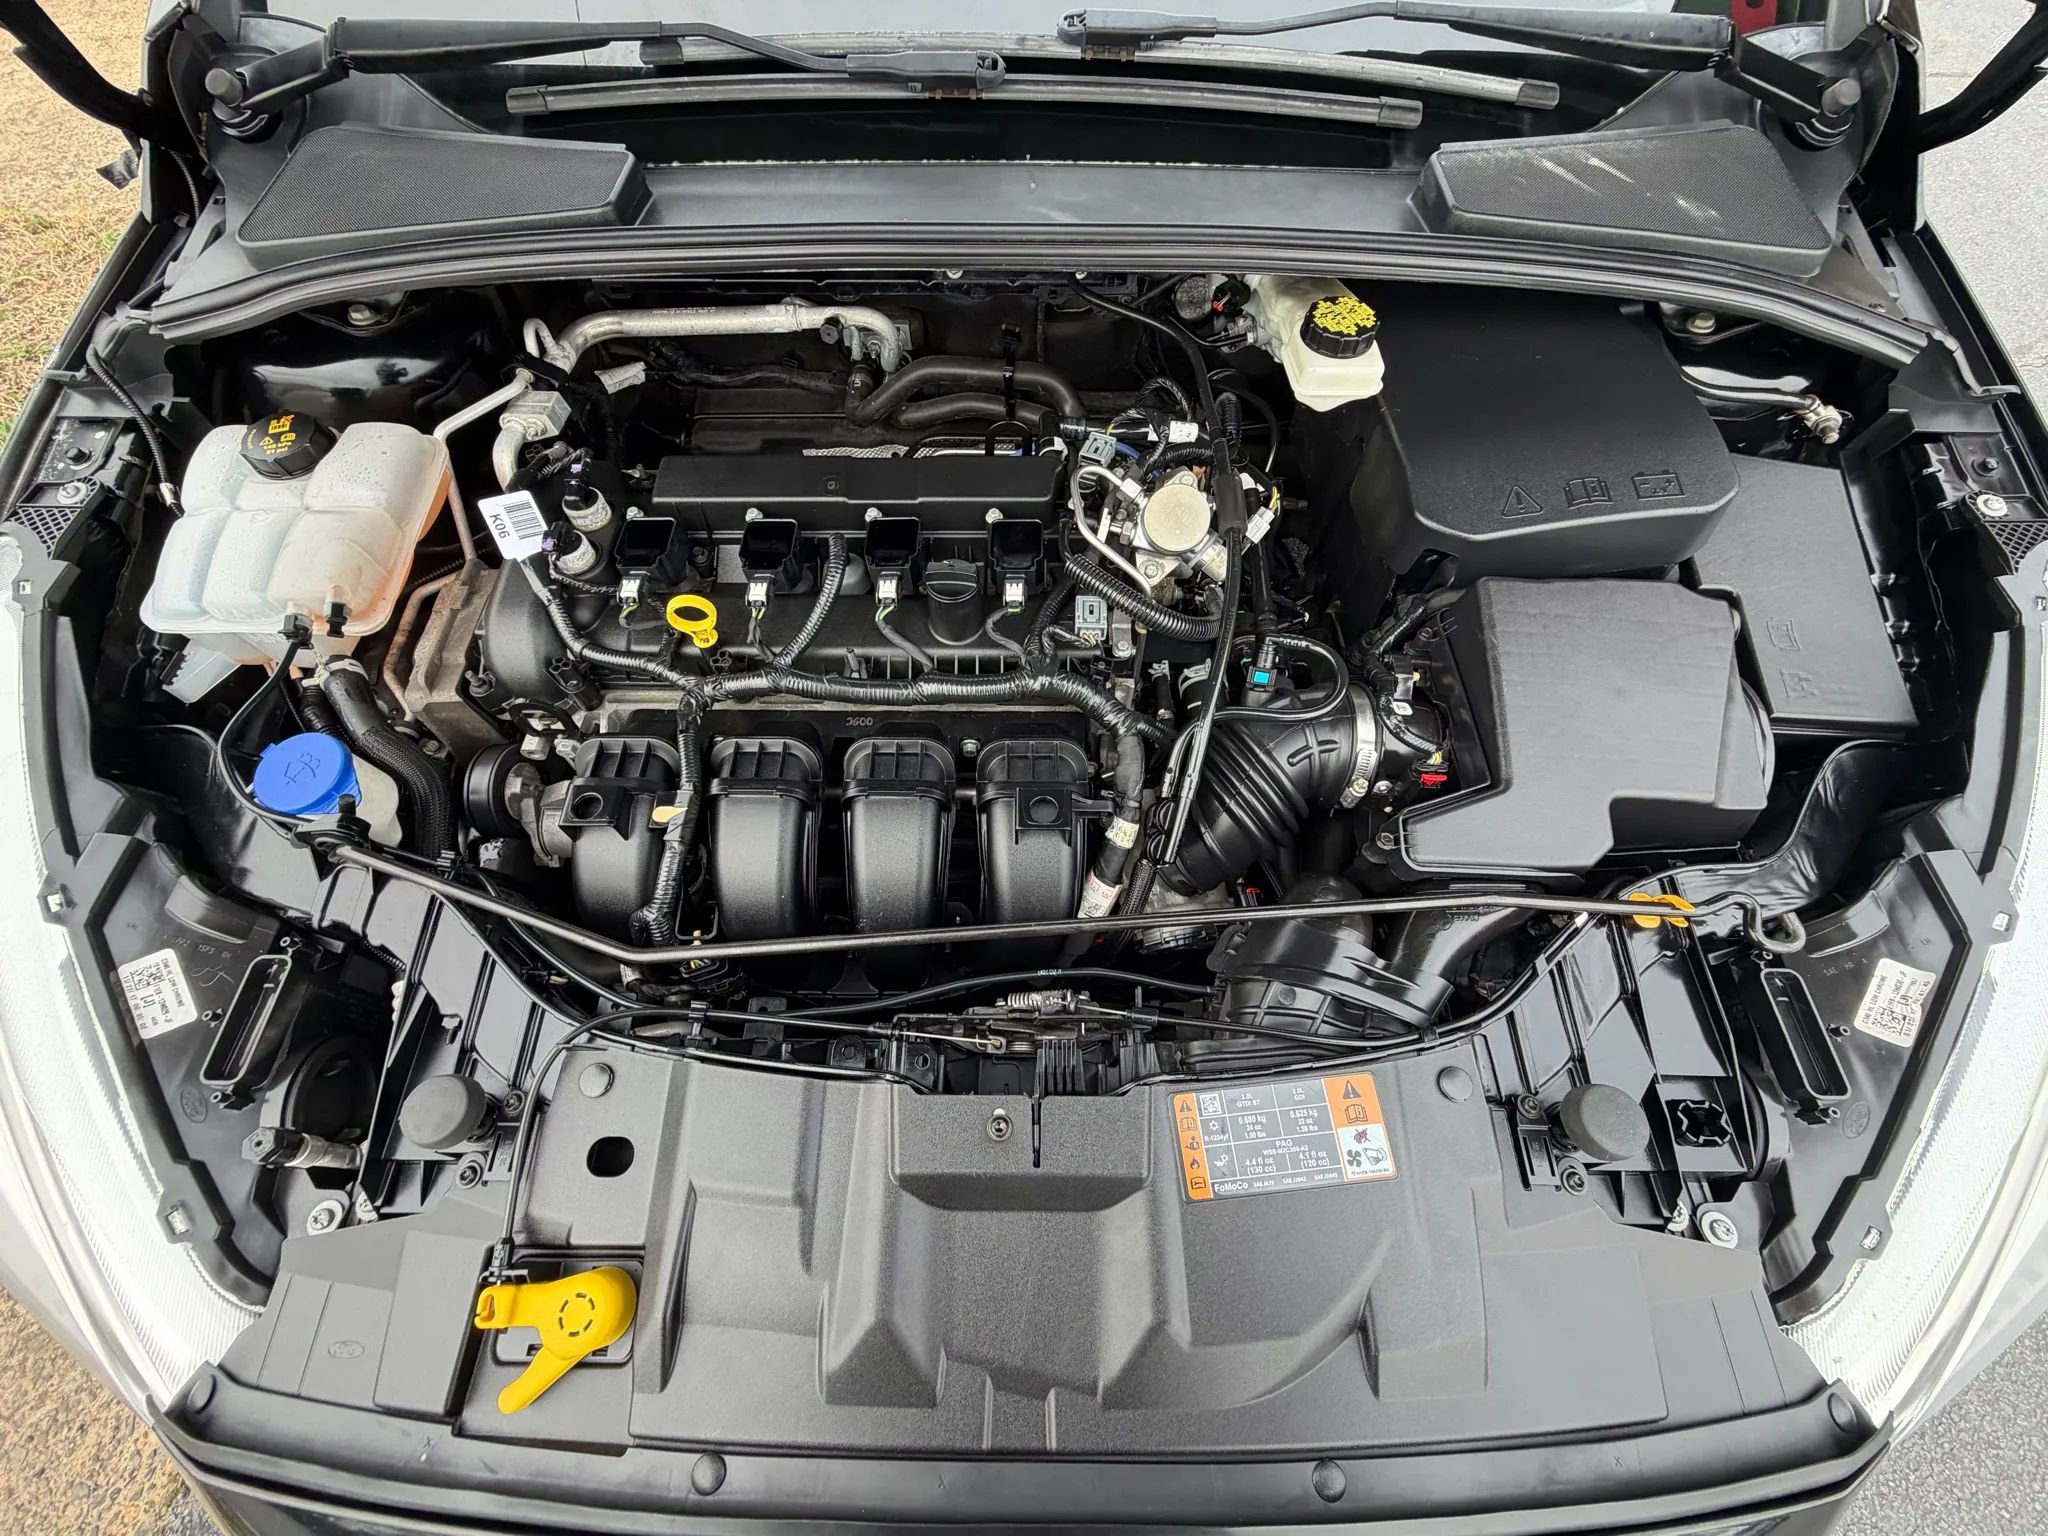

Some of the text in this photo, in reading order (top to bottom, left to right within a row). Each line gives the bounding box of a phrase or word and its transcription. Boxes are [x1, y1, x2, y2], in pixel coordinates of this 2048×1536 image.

[489, 513, 510, 539] K06
[1870, 993, 1879, 1005] LOW
[1876, 974, 1888, 994] CHROME
[1289, 1108, 1318, 1118] 0.625 kg
[1257, 1114, 1267, 1123] kg
[1275, 1139, 1293, 1148] PAG
[1299, 1151, 1310, 1160] 4.1
[1310, 1150, 1317, 1158] fl
[1245, 1158, 1256, 1166] 4.4
[1300, 1157, 1330, 1170] (120 cc)
[1247, 1163, 1277, 1176] (130 cc)
[1214, 1181, 1249, 1192] FoMoCo
